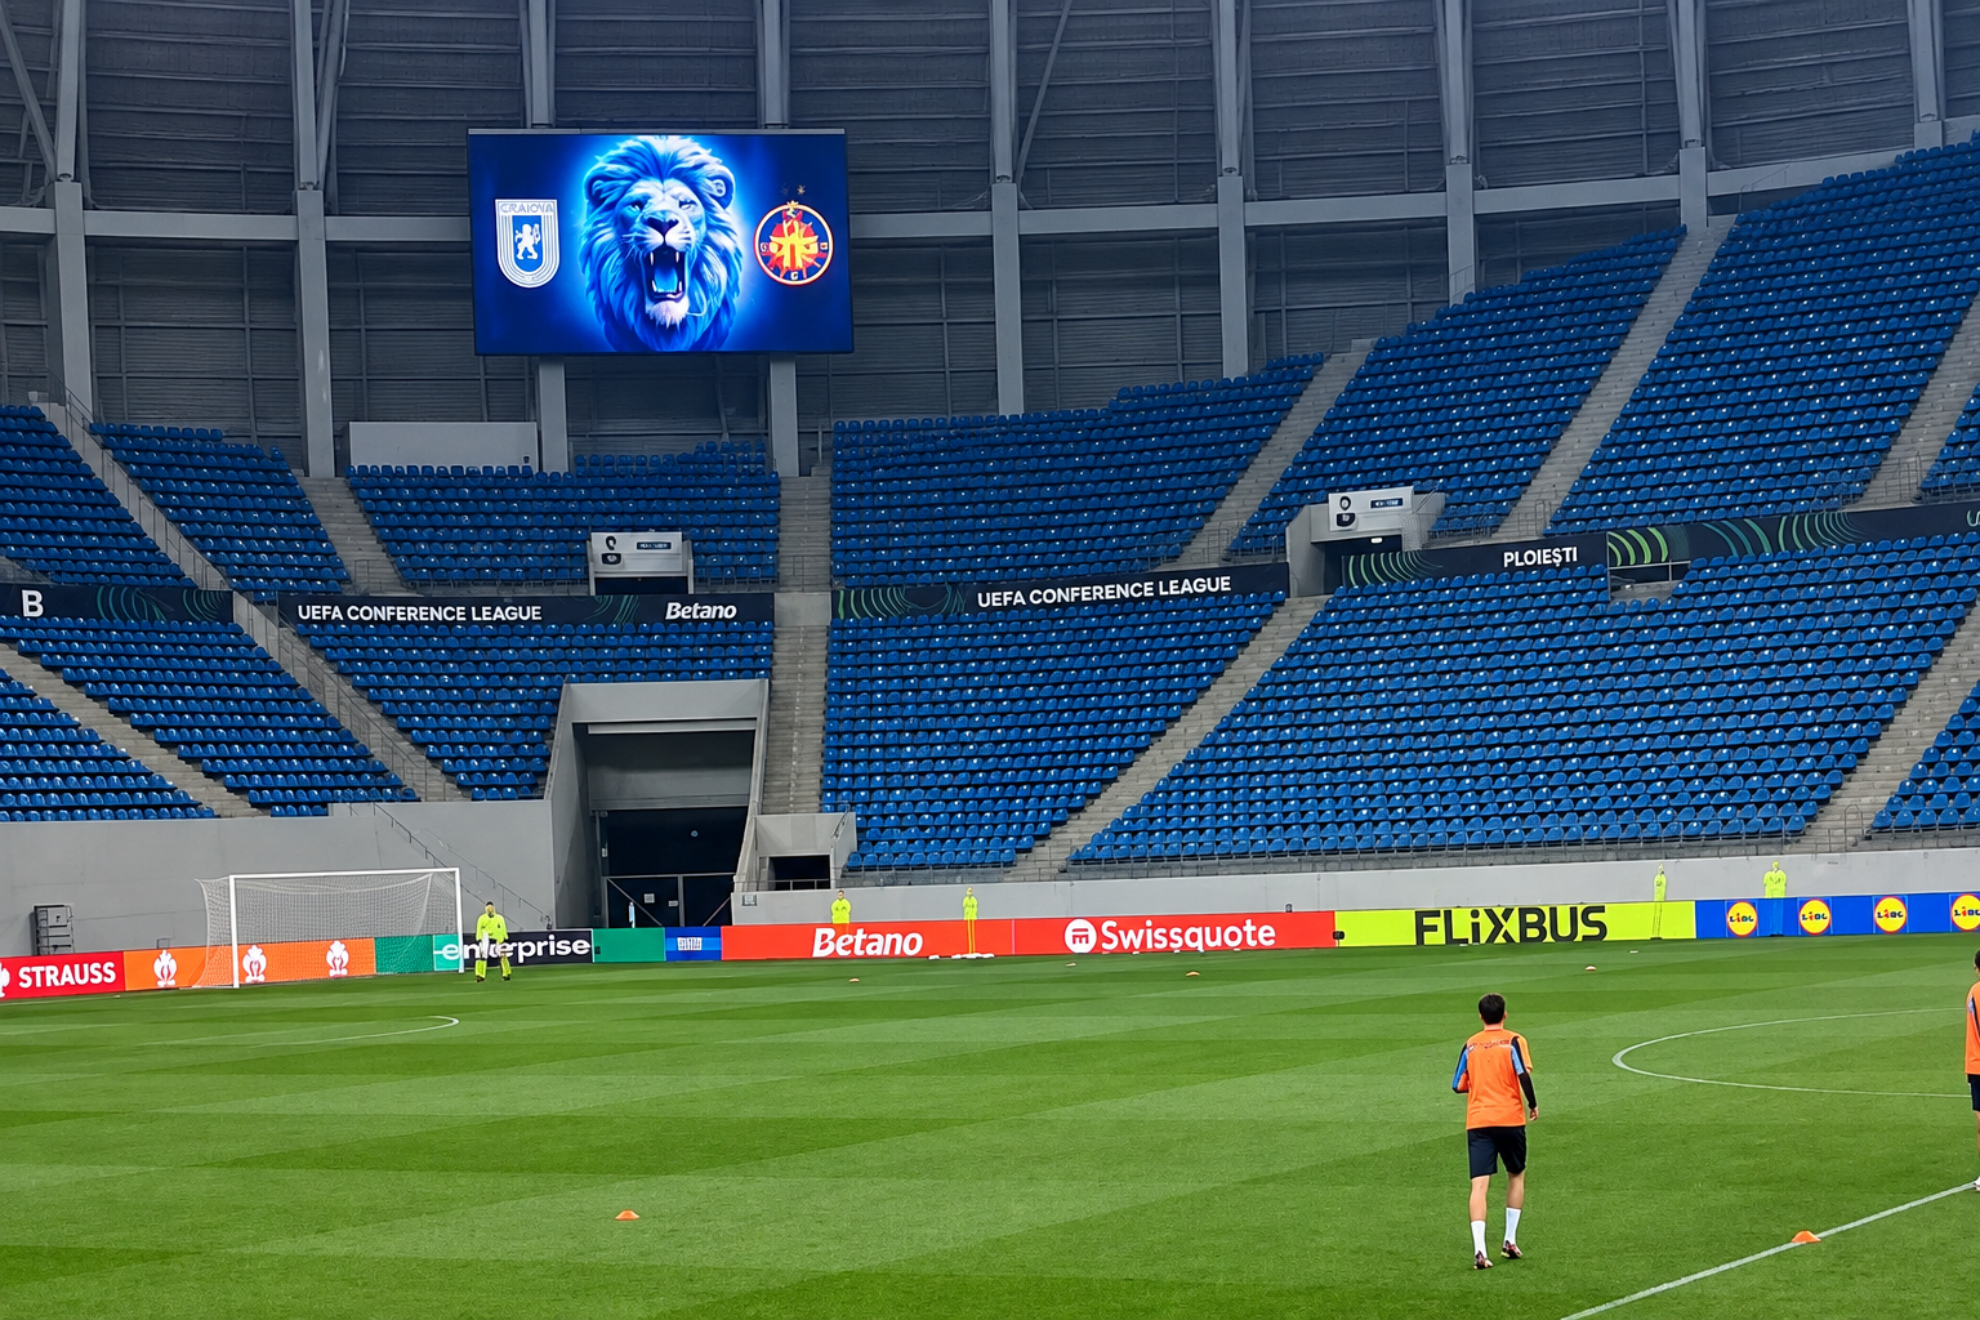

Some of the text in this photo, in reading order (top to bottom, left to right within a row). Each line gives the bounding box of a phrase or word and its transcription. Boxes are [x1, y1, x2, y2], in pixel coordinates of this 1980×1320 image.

[500, 203, 554, 213] CRAIOVA
[21, 589, 44, 618] B
[977, 576, 1232, 608] UEFA CONFERENCE LEAGUE
[297, 605, 542, 622] UEFA CONFERENCE LEAGUE
[665, 602, 738, 621] Betano
[812, 927, 924, 958] Betano
[1101, 918, 1276, 952] Swissquote
[18, 961, 117, 989] STRAUSS
